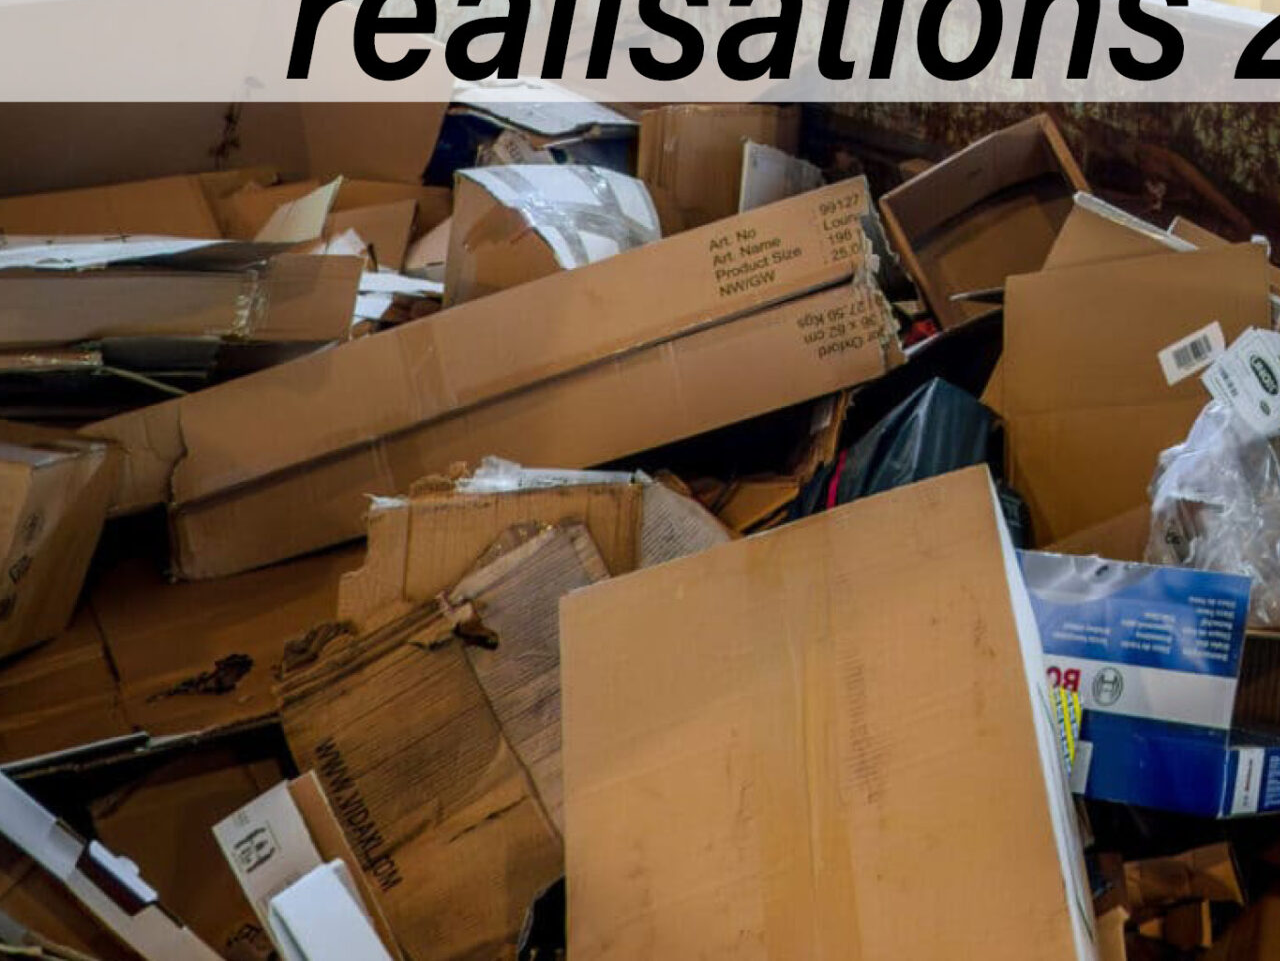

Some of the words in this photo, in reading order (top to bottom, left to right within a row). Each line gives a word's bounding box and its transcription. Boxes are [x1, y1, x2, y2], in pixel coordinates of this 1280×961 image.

[738, 237, 782, 258] Name
[714, 257, 770, 283] Product
[771, 246, 803, 264] Size
[718, 269, 778, 298] NW/GW
